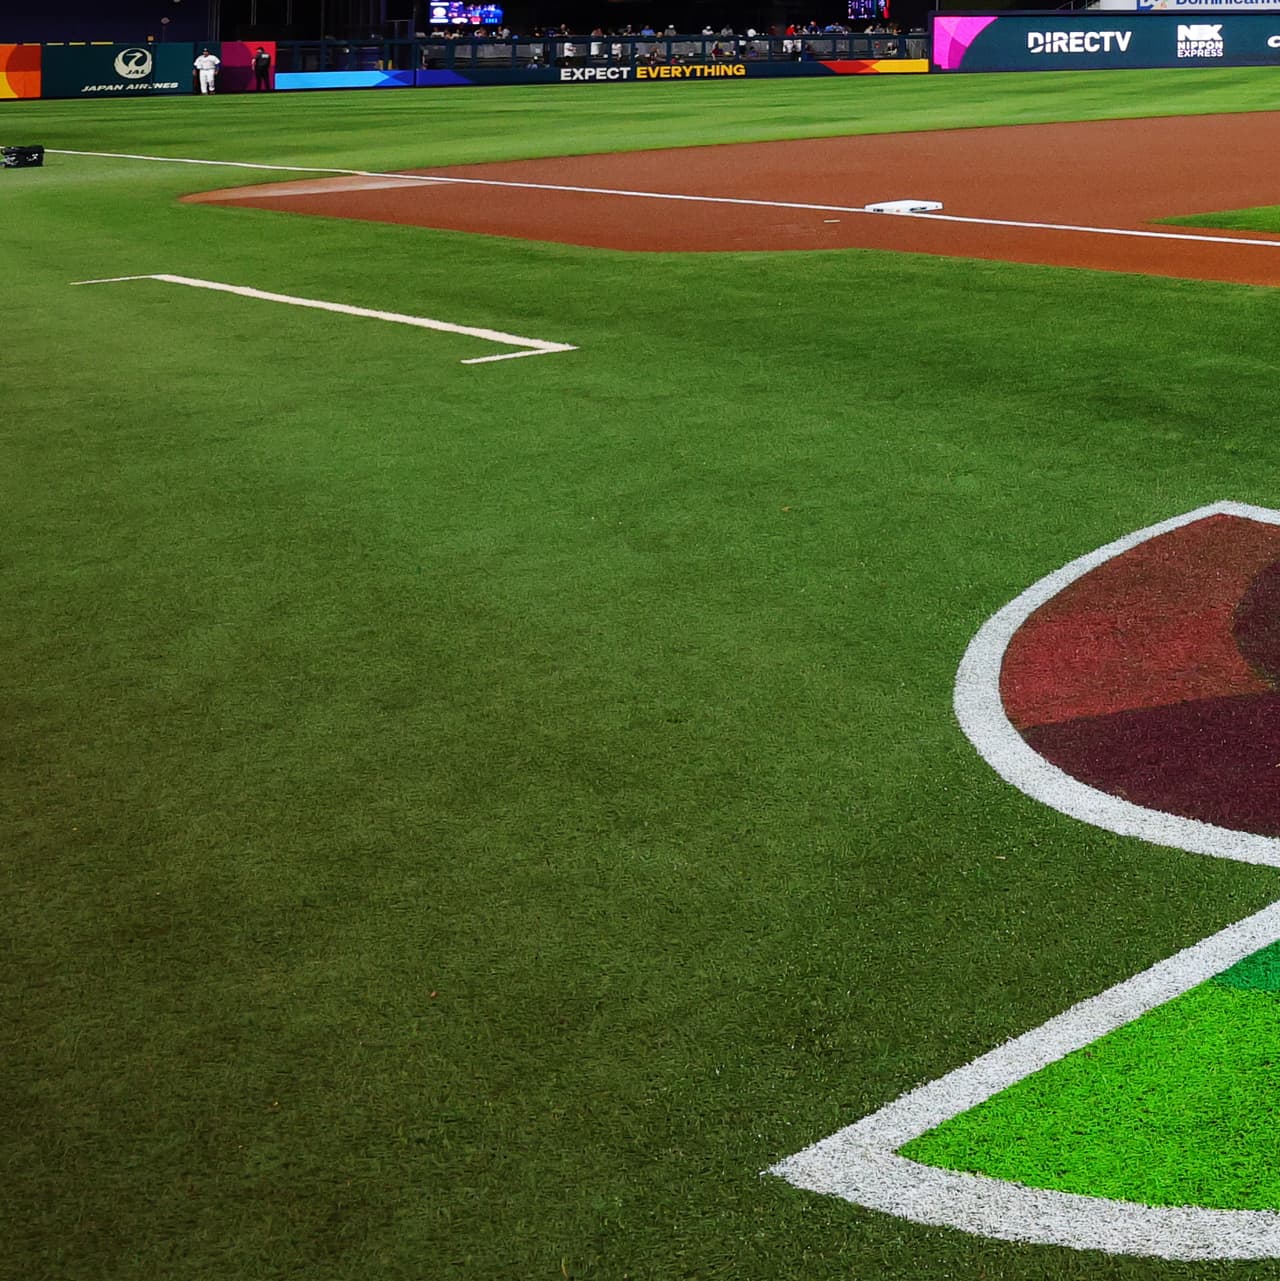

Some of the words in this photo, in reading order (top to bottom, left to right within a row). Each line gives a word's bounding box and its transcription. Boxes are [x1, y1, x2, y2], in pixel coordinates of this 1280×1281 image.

[1027, 31, 1132, 54] DIRECTV
[1177, 40, 1224, 50] NIPPON
[1177, 49, 1224, 58] EXPRESS
[560, 67, 631, 81] EXPECT
[636, 64, 746, 79] EVERYTHING
[81, 84, 124, 92] JAPAN
